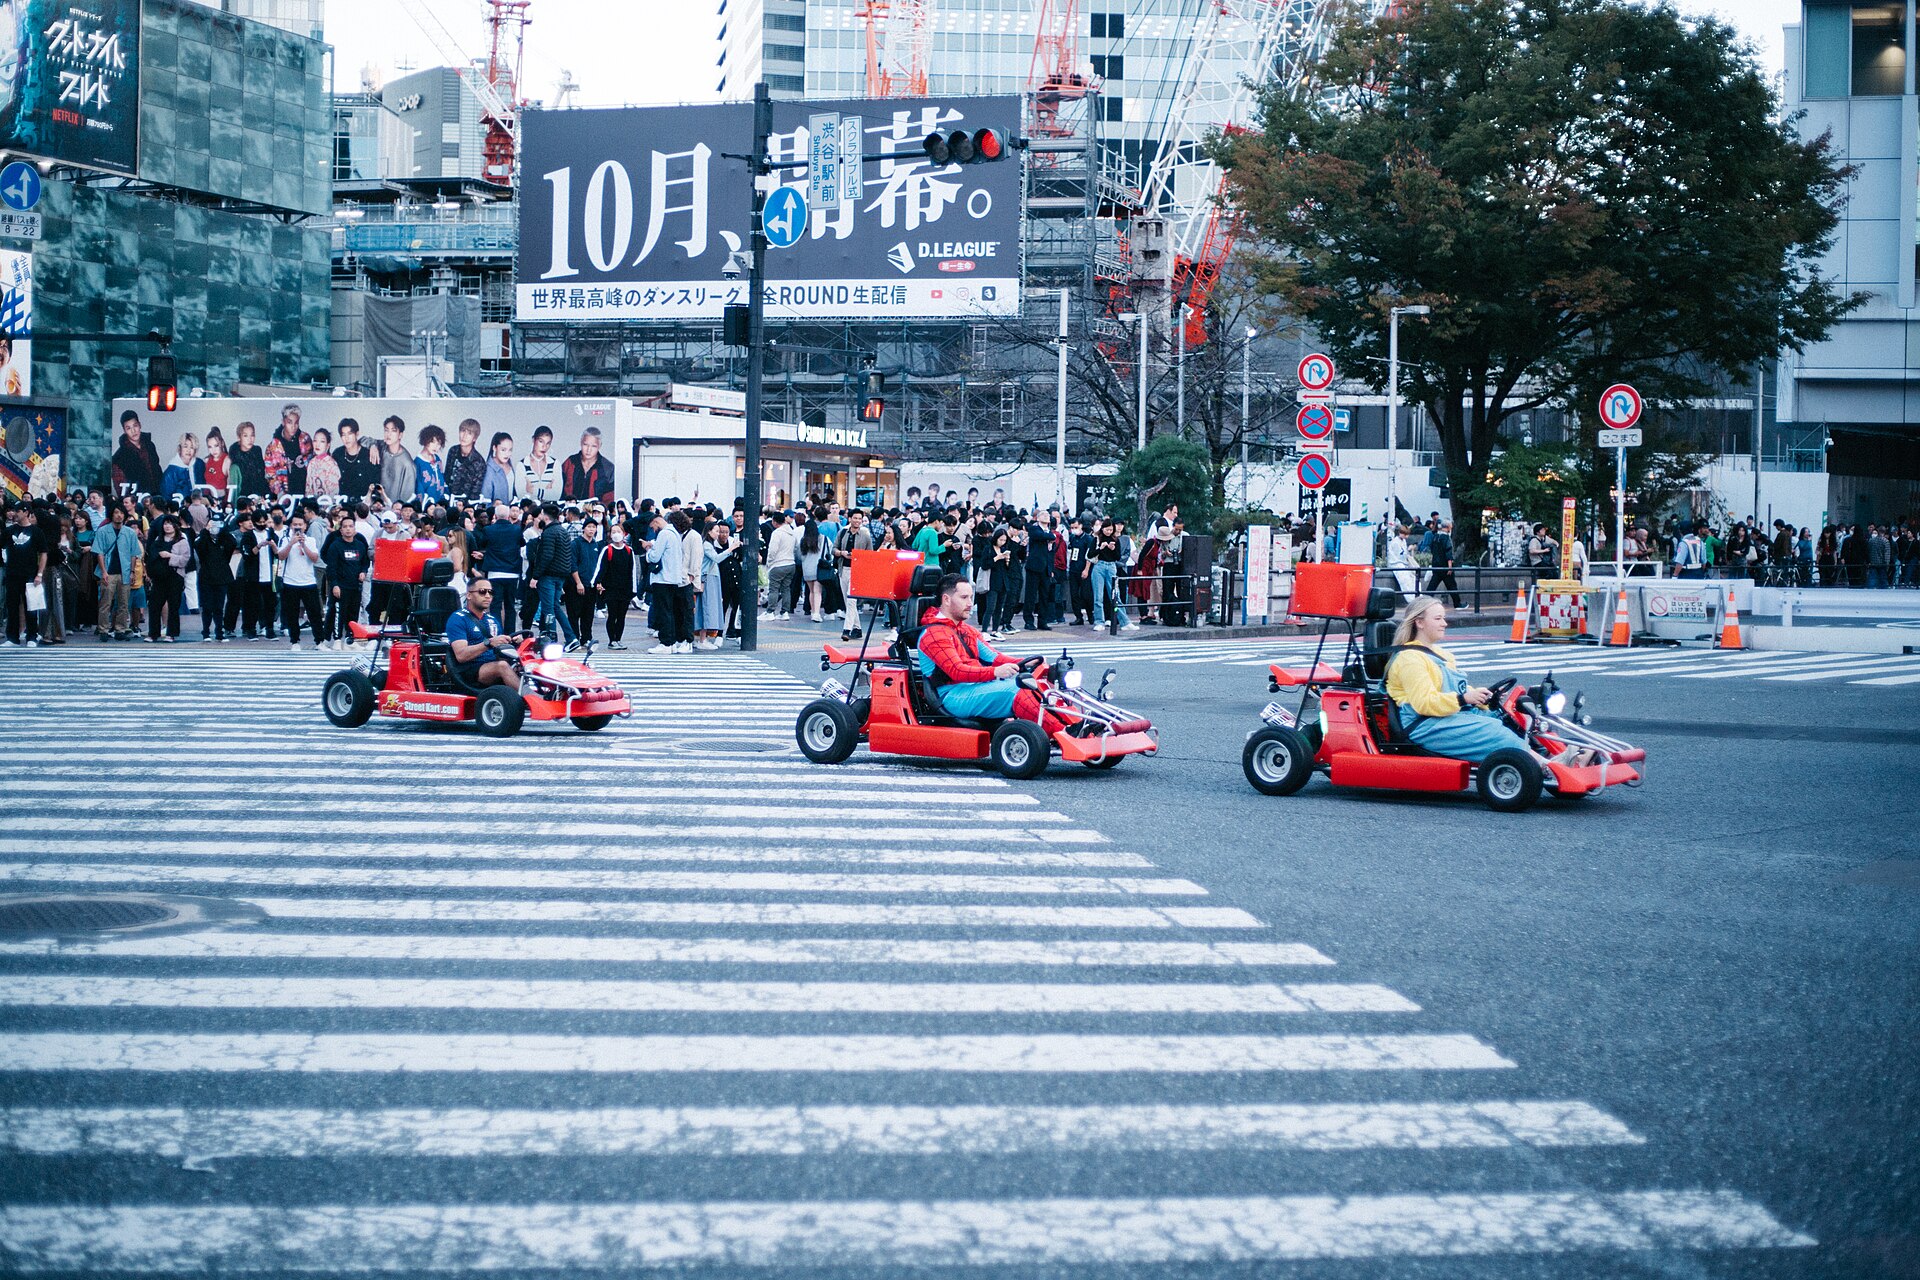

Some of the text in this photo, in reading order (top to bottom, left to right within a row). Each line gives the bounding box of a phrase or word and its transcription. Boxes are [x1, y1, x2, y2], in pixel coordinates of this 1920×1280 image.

[52, 108, 78, 126] NETFLIX
[812, 135, 820, 171] Shibuya
[822, 121, 835, 202] 渋谷駅前
[531, 286, 743, 310] 世界最高峰のダンスリーグ
[1602, 434, 1638, 444] ここまで
[404, 701, 425, 711] Street
